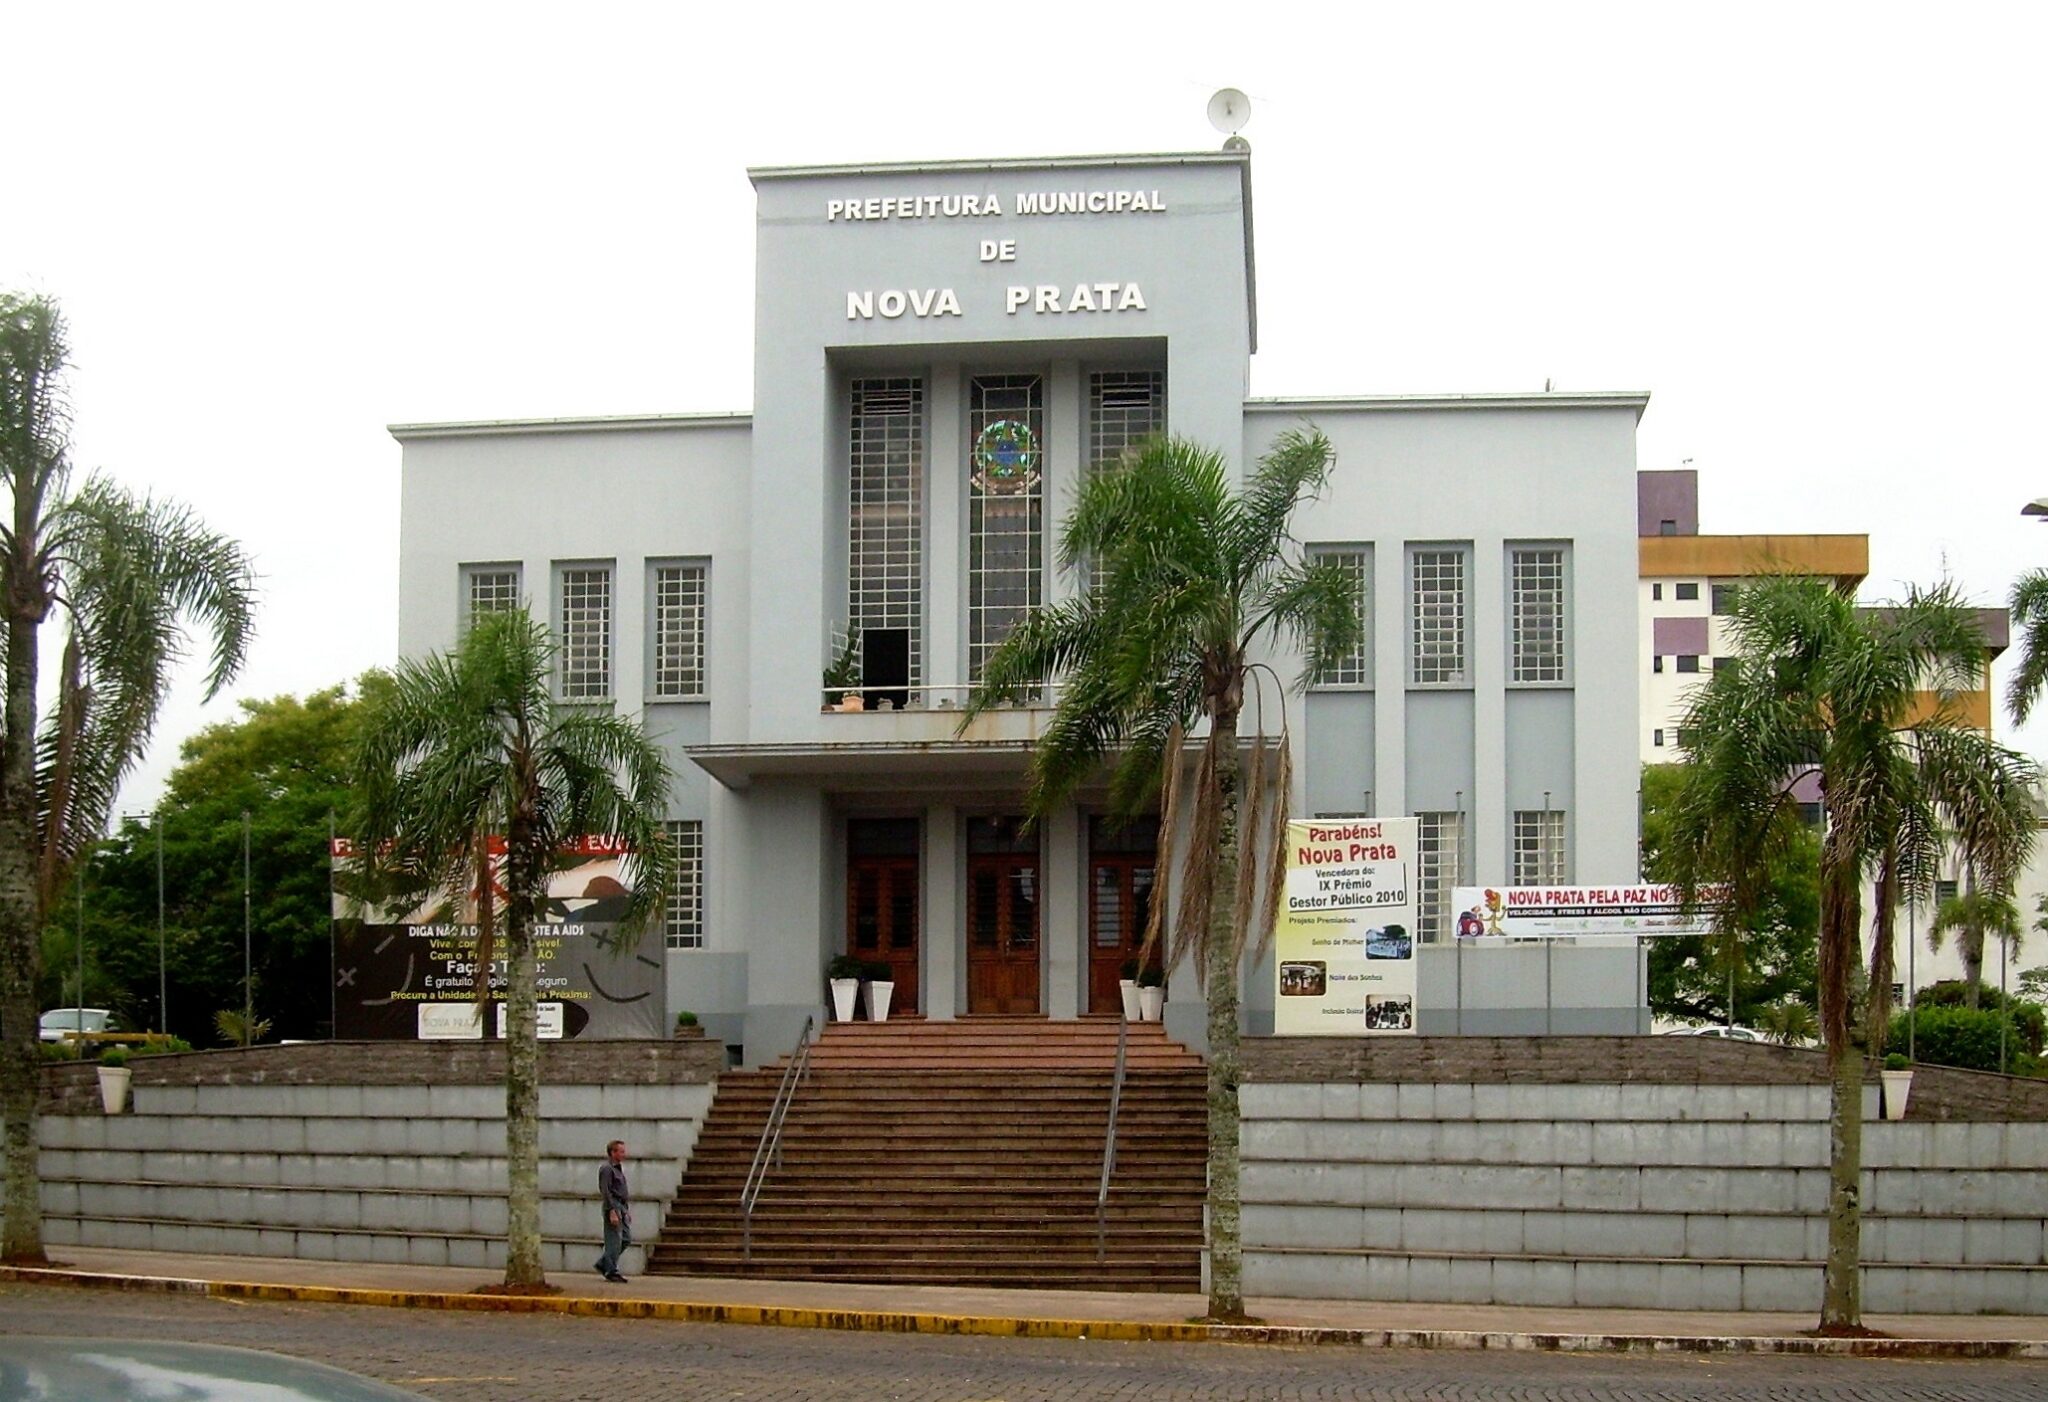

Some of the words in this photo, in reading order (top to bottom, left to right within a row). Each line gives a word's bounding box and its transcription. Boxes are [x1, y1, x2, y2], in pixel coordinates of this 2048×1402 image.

[827, 194, 1001, 221] PREFEITURA
[1016, 190, 1166, 215] MUNICIPAL
[980, 240, 1016, 262] DE
[846, 289, 962, 319] NOVA
[1006, 282, 1147, 314] PRATA
[1309, 823, 1382, 842] Parabéns!
[1298, 847, 1343, 865] Nova
[1349, 843, 1396, 861] Prata
[1316, 868, 1360, 877] Vencedora
[1319, 880, 1331, 891] IX
[1334, 878, 1372, 890] Prêmio
[1289, 896, 1327, 908] Gestor
[1331, 892, 1373, 906] Público
[1376, 890, 1404, 903] 2010
[1508, 891, 1542, 905] NOVA
[1546, 890, 1585, 905] PRATA
[1589, 890, 1620, 904] PELA
[1623, 889, 1647, 903] PAZ
[1650, 889, 1669, 903] NO
[408, 926, 434, 937] DIGA
[561, 924, 584, 936] AIDS
[429, 951, 453, 960] Com
[535, 949, 556, 960] ÃO.
[446, 960, 481, 976] Faça
[390, 991, 428, 1000] Procure
[437, 990, 477, 1000] Unidade
